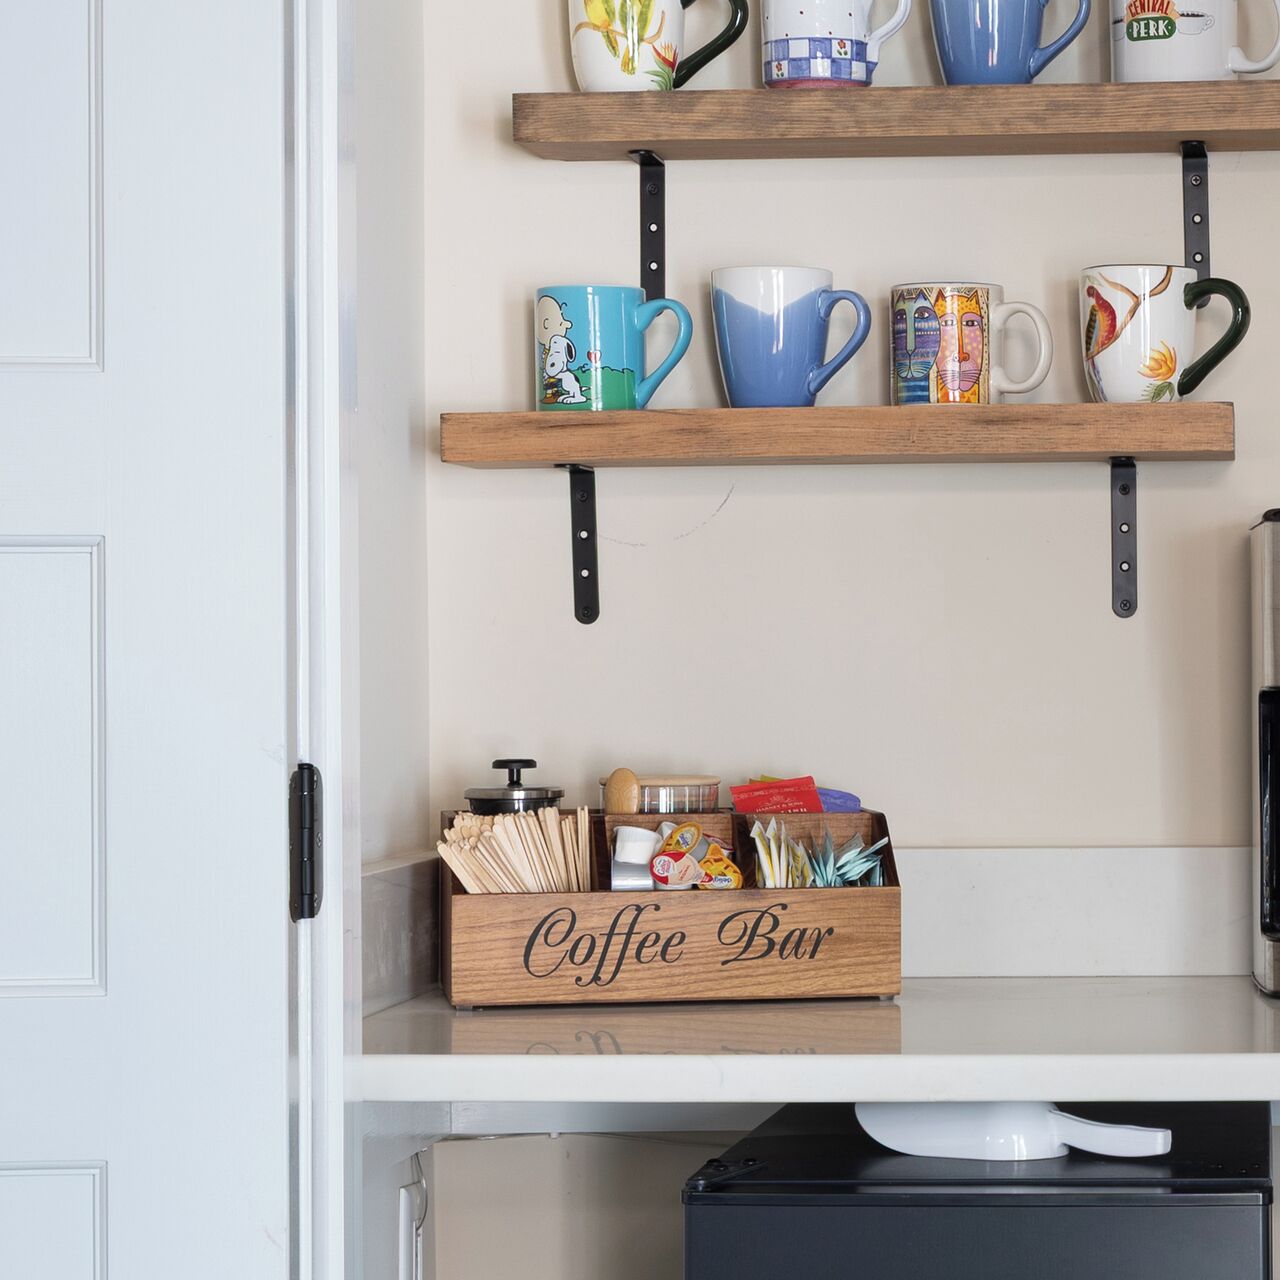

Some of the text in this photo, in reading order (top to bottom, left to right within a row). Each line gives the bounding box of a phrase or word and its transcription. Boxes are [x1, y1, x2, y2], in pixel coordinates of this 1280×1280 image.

[1132, 20, 1169, 38] PERK
[522, 903, 834, 988] Coffee Bar
